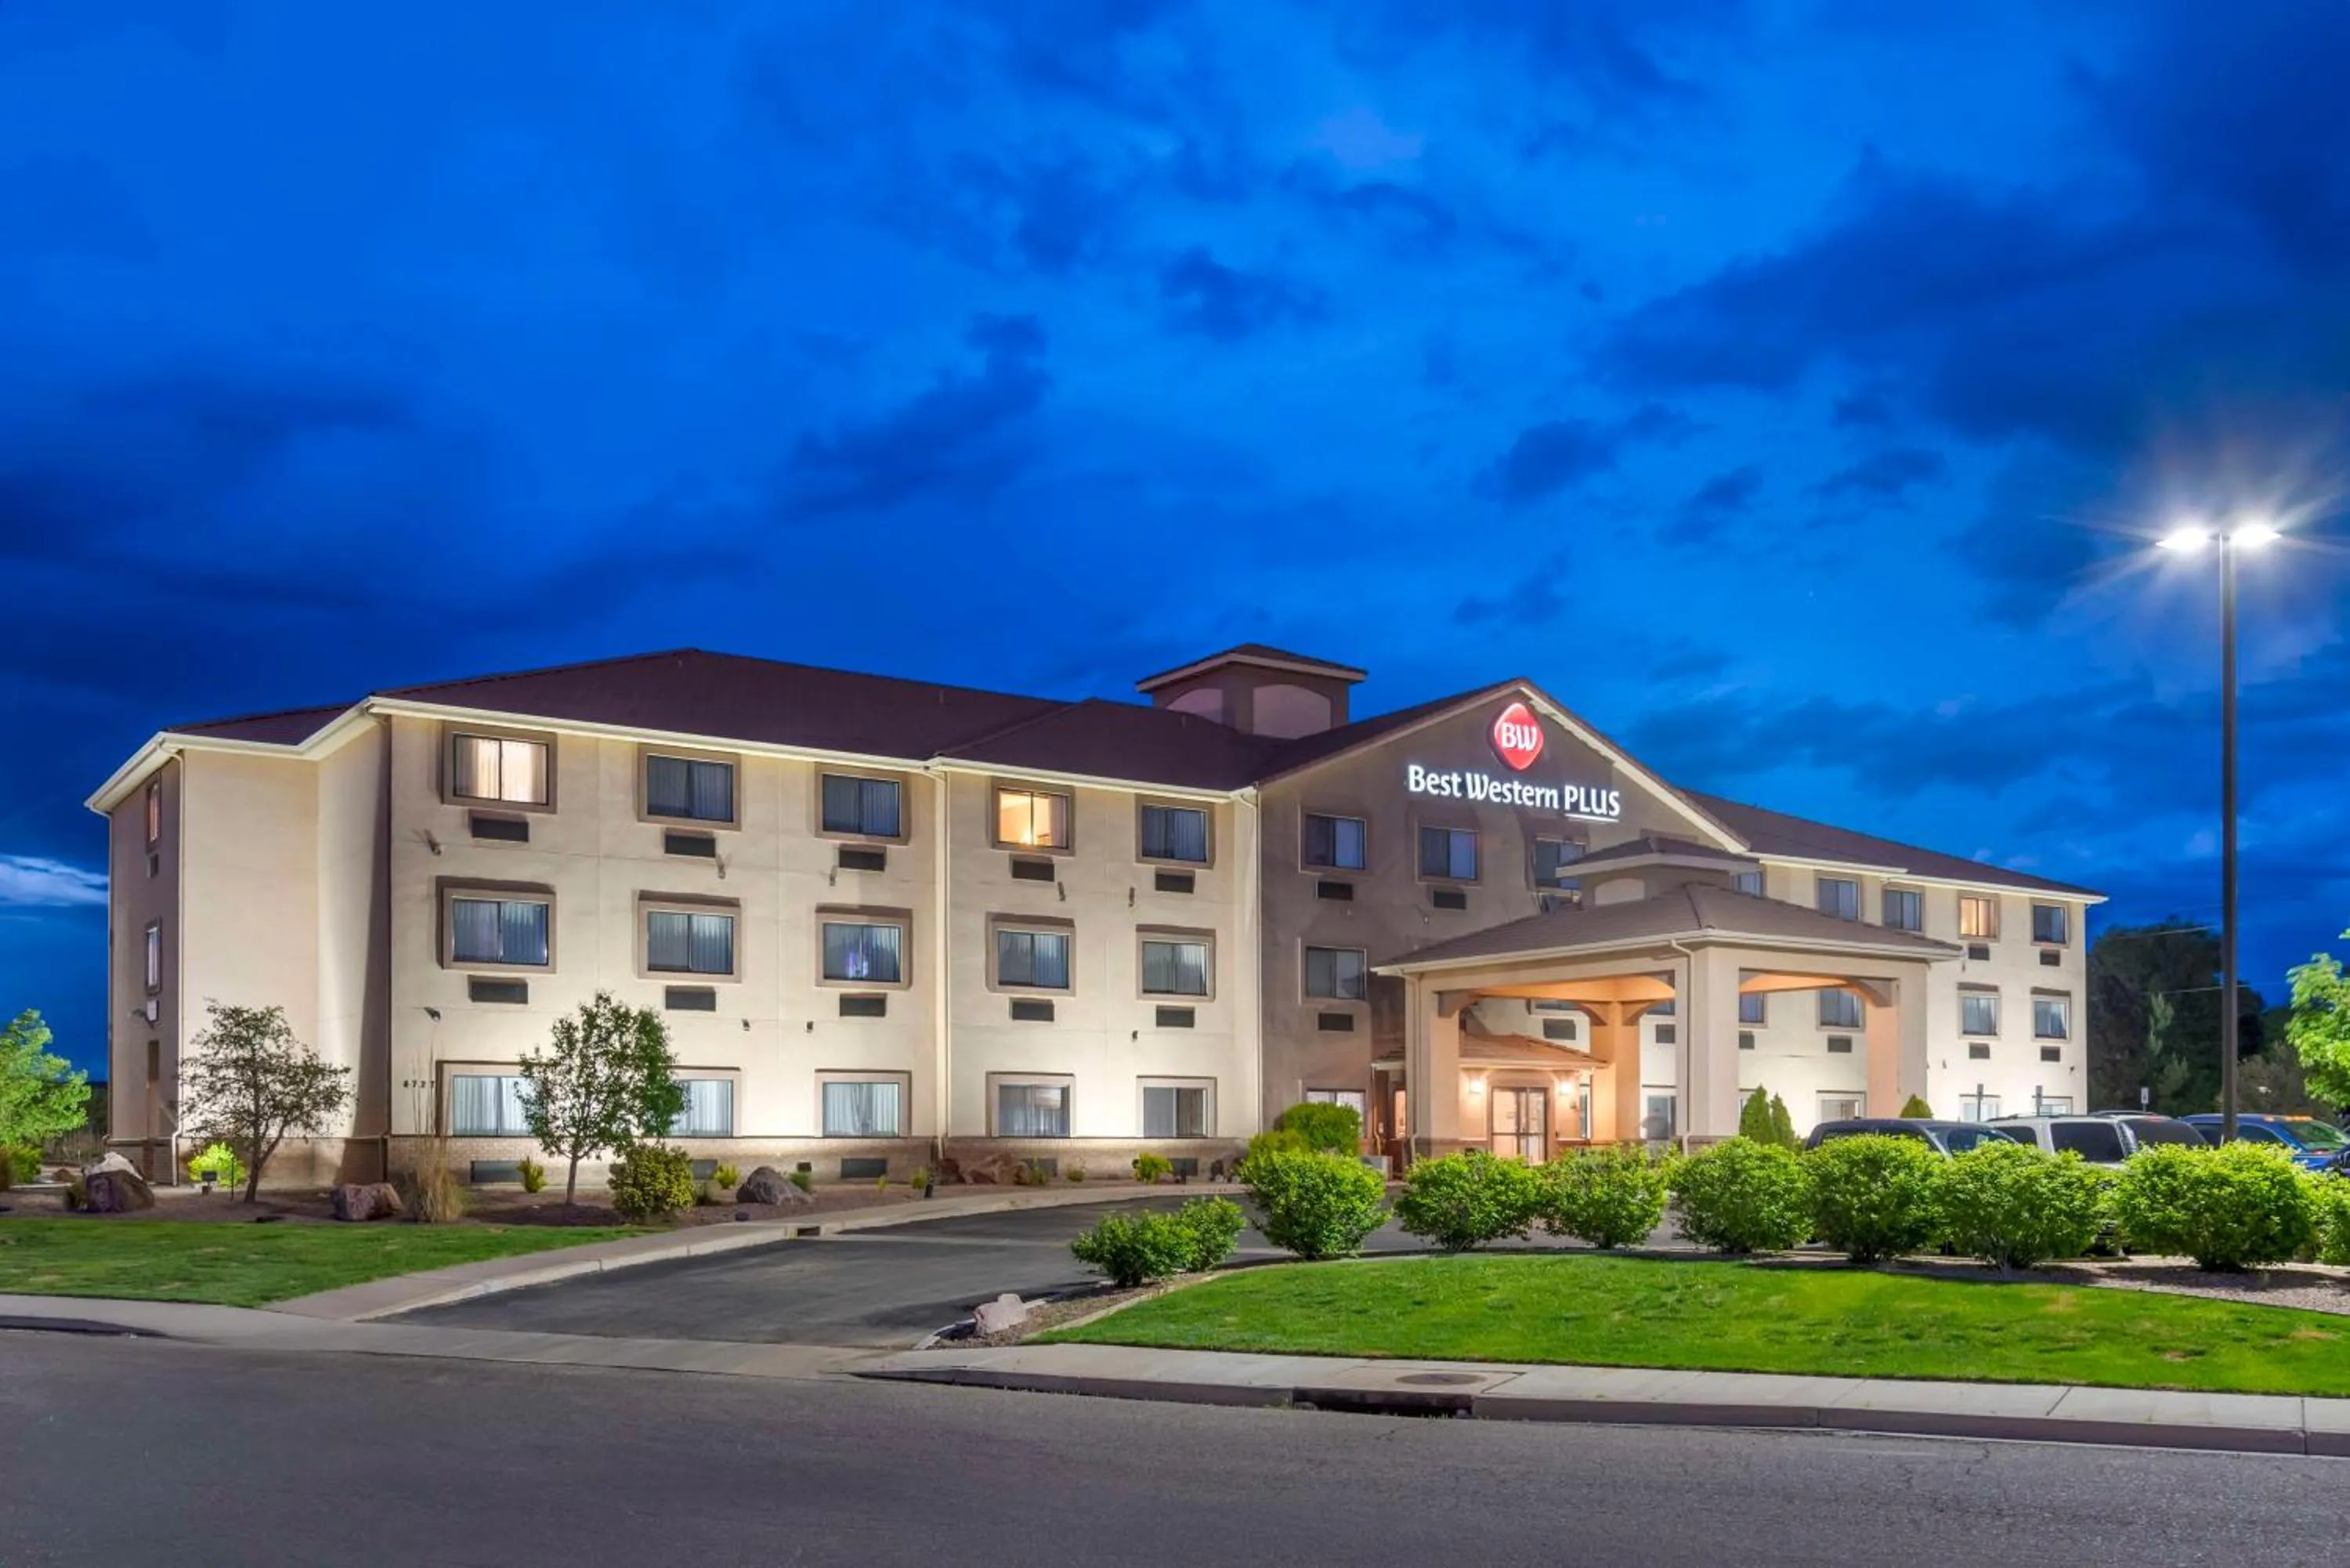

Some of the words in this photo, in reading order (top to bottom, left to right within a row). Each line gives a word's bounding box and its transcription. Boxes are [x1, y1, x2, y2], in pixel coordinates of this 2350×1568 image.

[1501, 722, 1537, 750] BW
[1408, 764, 1462, 797] Best
[1466, 772, 1559, 809] Western
[1564, 785, 1620, 816] PLUS
